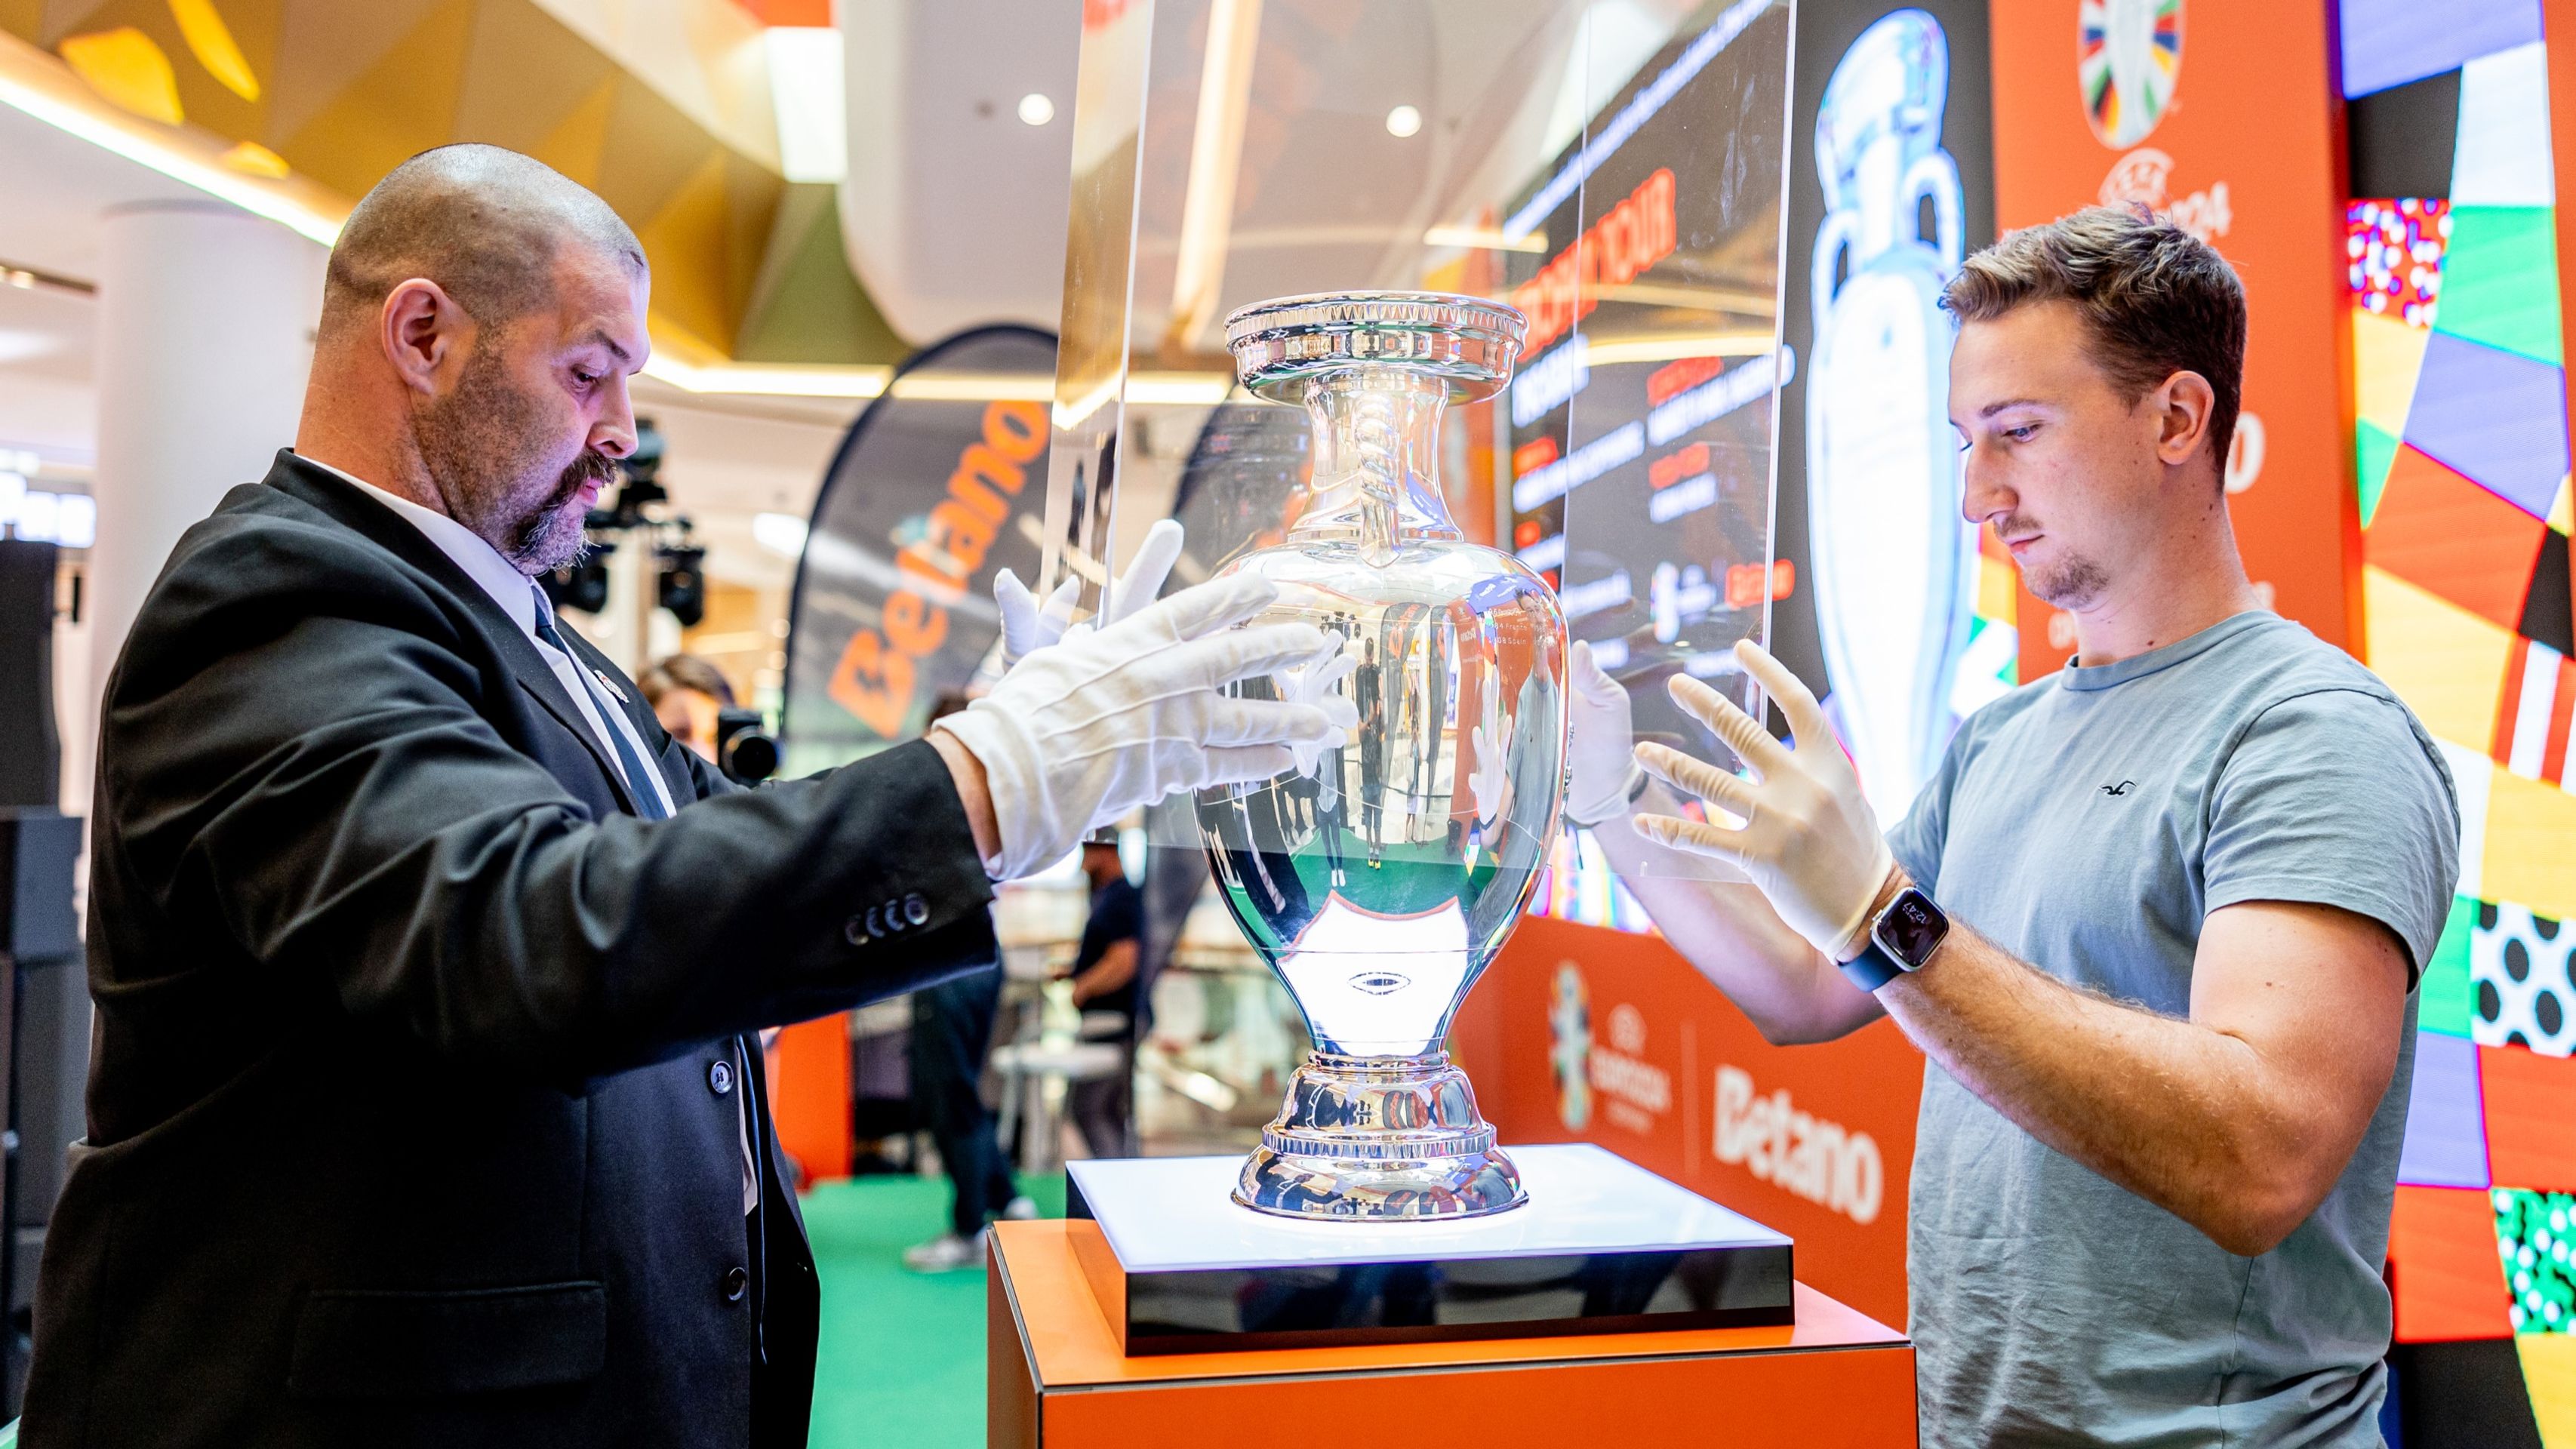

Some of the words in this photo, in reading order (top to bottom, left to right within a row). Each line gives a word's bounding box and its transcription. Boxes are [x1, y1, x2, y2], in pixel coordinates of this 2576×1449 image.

[827, 399, 1051, 740] Betano
[1903, 902, 1926, 924] 12:47
[1712, 1063, 1884, 1224] Betano
